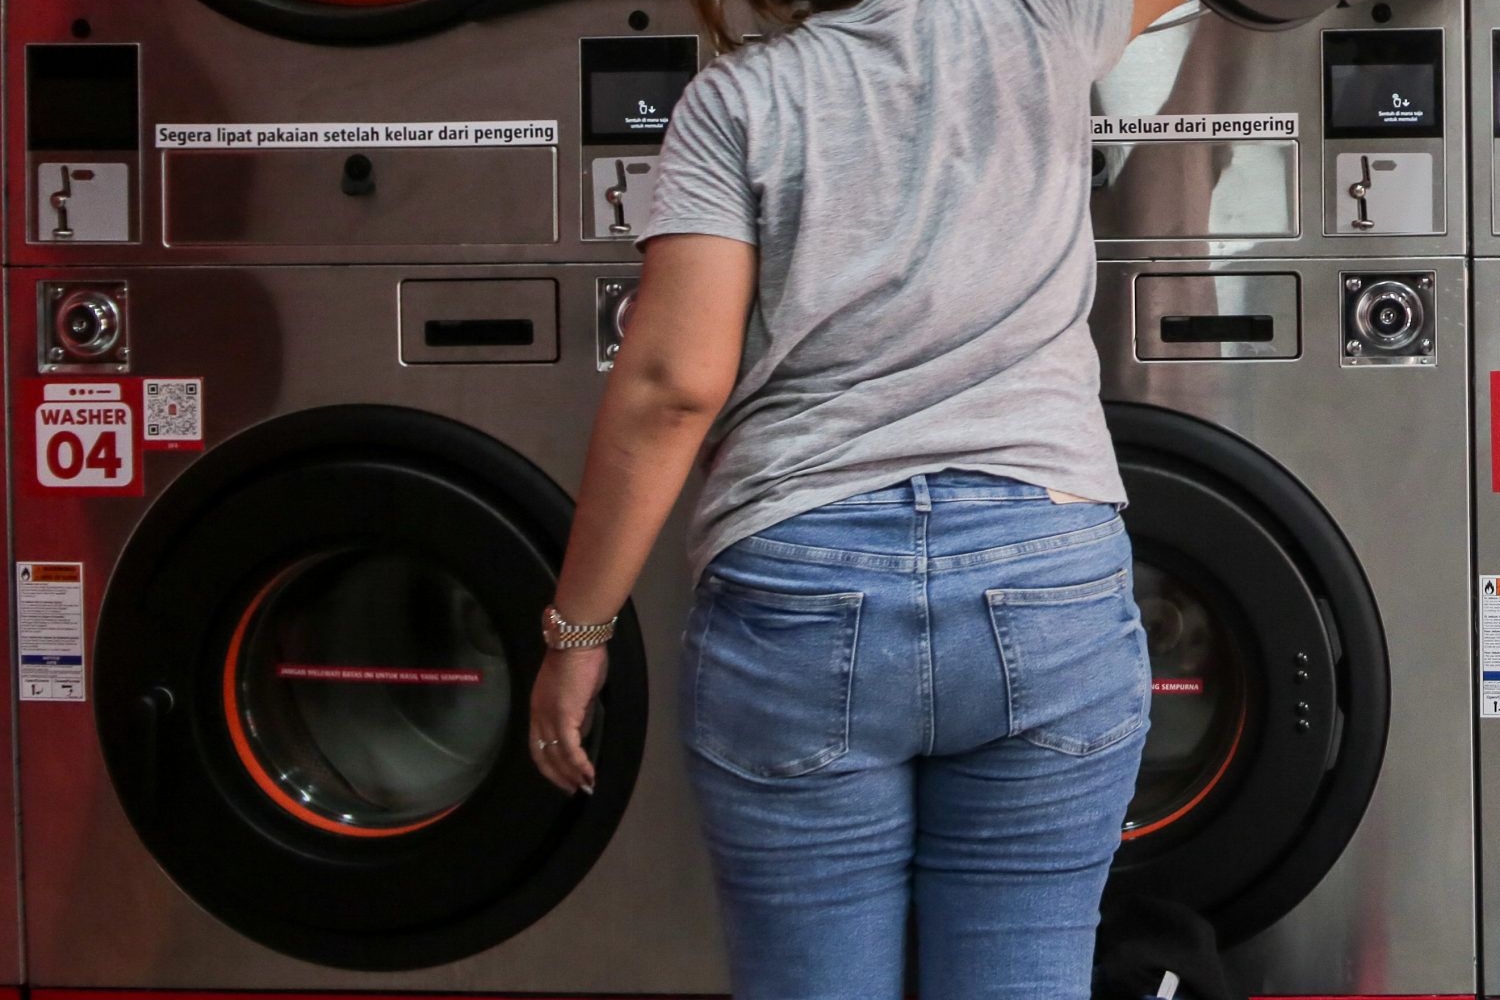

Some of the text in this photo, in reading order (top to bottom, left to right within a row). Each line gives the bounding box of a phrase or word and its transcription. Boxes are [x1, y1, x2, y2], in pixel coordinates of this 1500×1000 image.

[159, 124, 554, 146] Segera lipat pakaian setelah keluar dari pengering
[1119, 116, 1294, 136] keluar dari pengering
[41, 409, 126, 425] WASHER
[47, 431, 122, 479] 04
[1161, 683, 1199, 691] SEMPURNA
